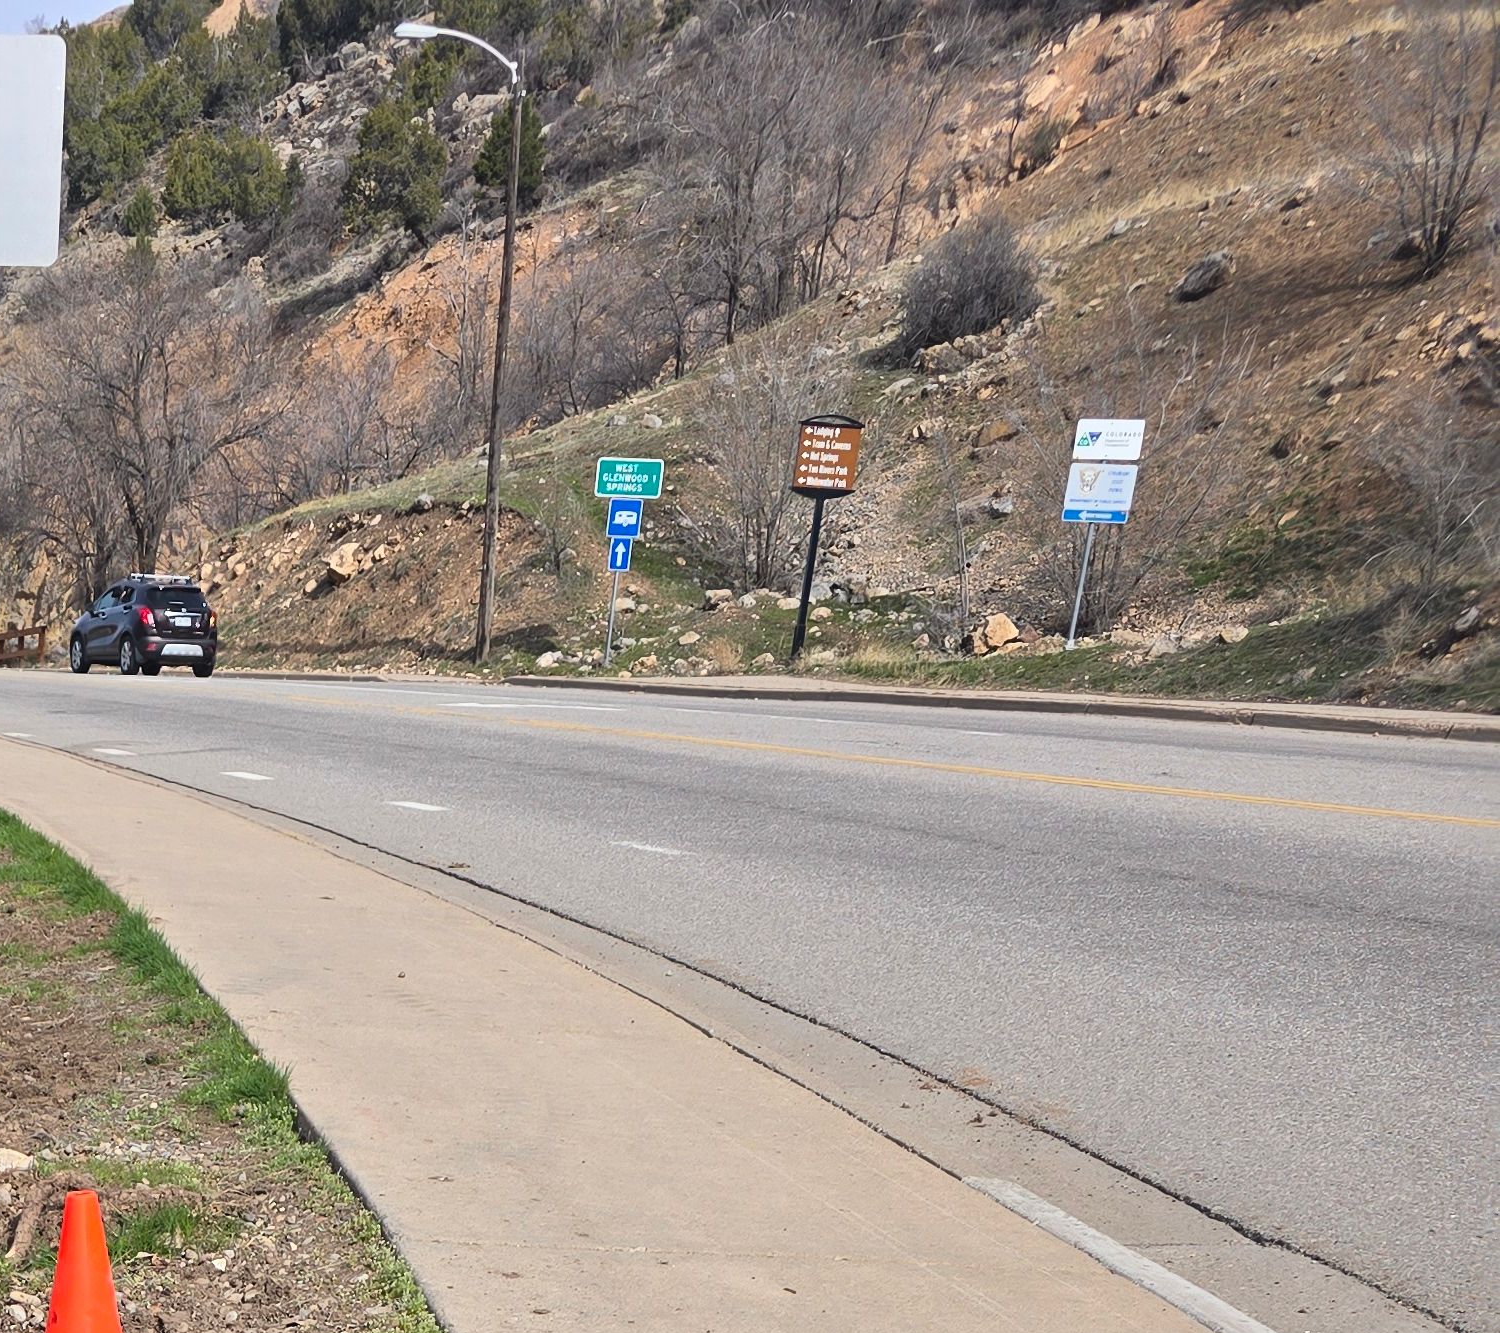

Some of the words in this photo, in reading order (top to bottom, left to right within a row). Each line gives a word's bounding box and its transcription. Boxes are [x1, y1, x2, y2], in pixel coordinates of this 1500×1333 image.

[616, 464, 639, 472] WEST
[603, 473, 648, 483] GLENWOOD
[606, 483, 642, 492] SPRINGS
